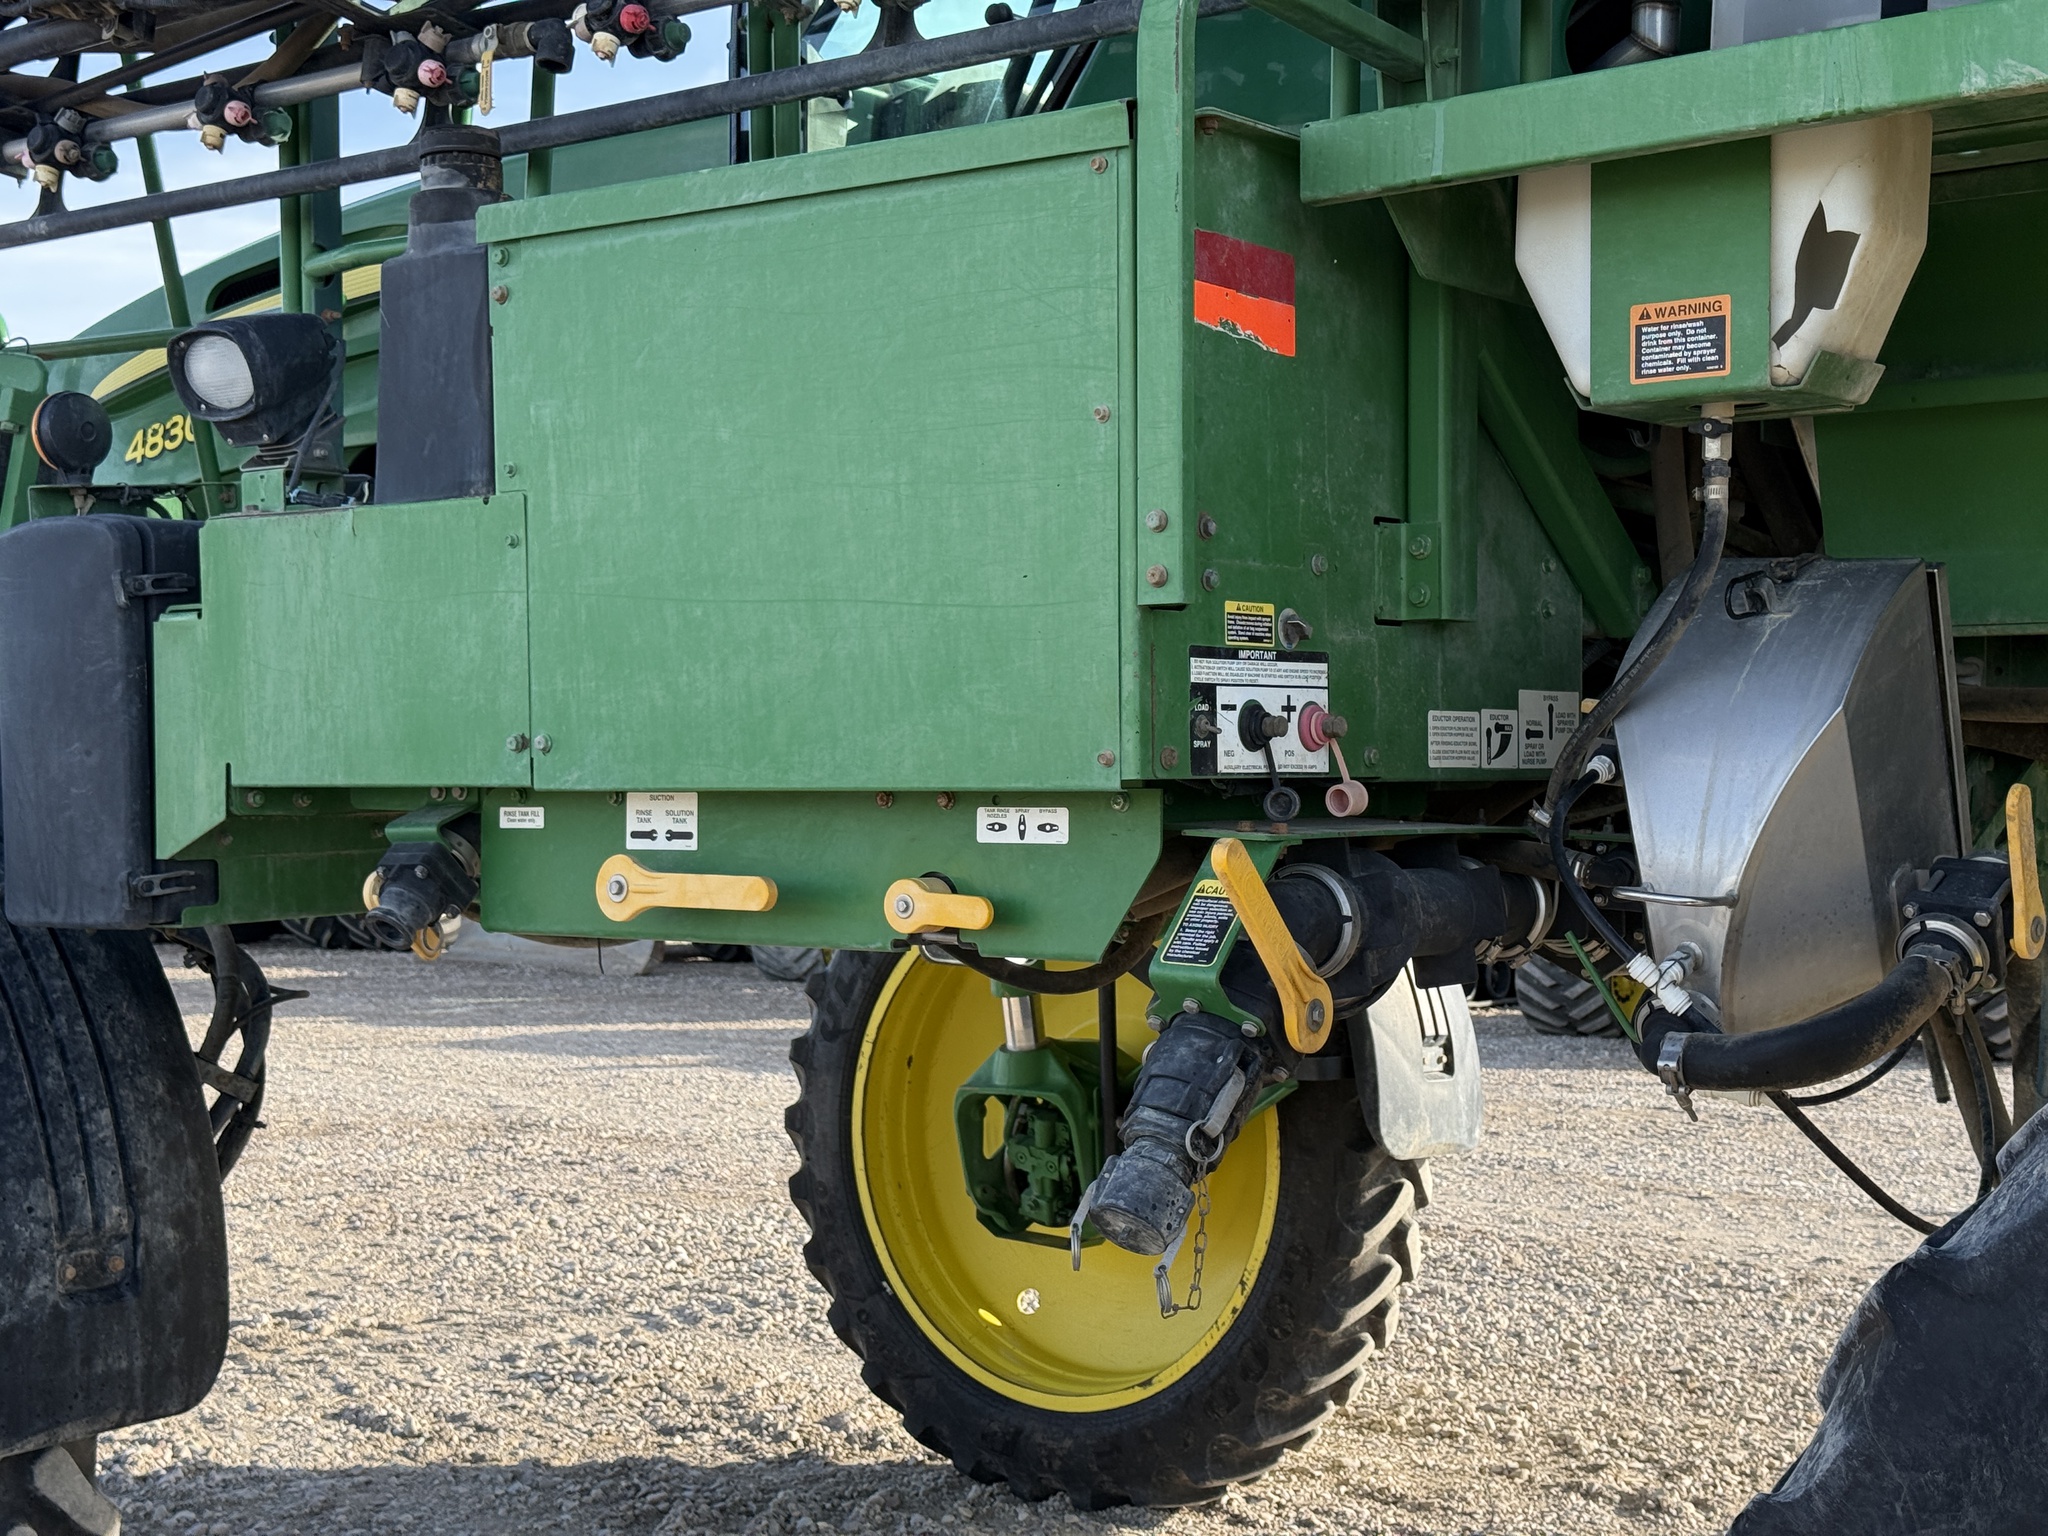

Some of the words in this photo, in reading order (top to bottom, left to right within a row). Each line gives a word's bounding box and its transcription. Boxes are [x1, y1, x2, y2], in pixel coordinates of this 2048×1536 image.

[1654, 300, 1722, 318] WARNING
[1642, 332, 1666, 341] purpose
[1687, 334, 1718, 342] container.
[1642, 351, 1682, 360] contaminated
[1642, 360, 1674, 368] chemicals.
[1238, 650, 1276, 660] IMPORTANT
